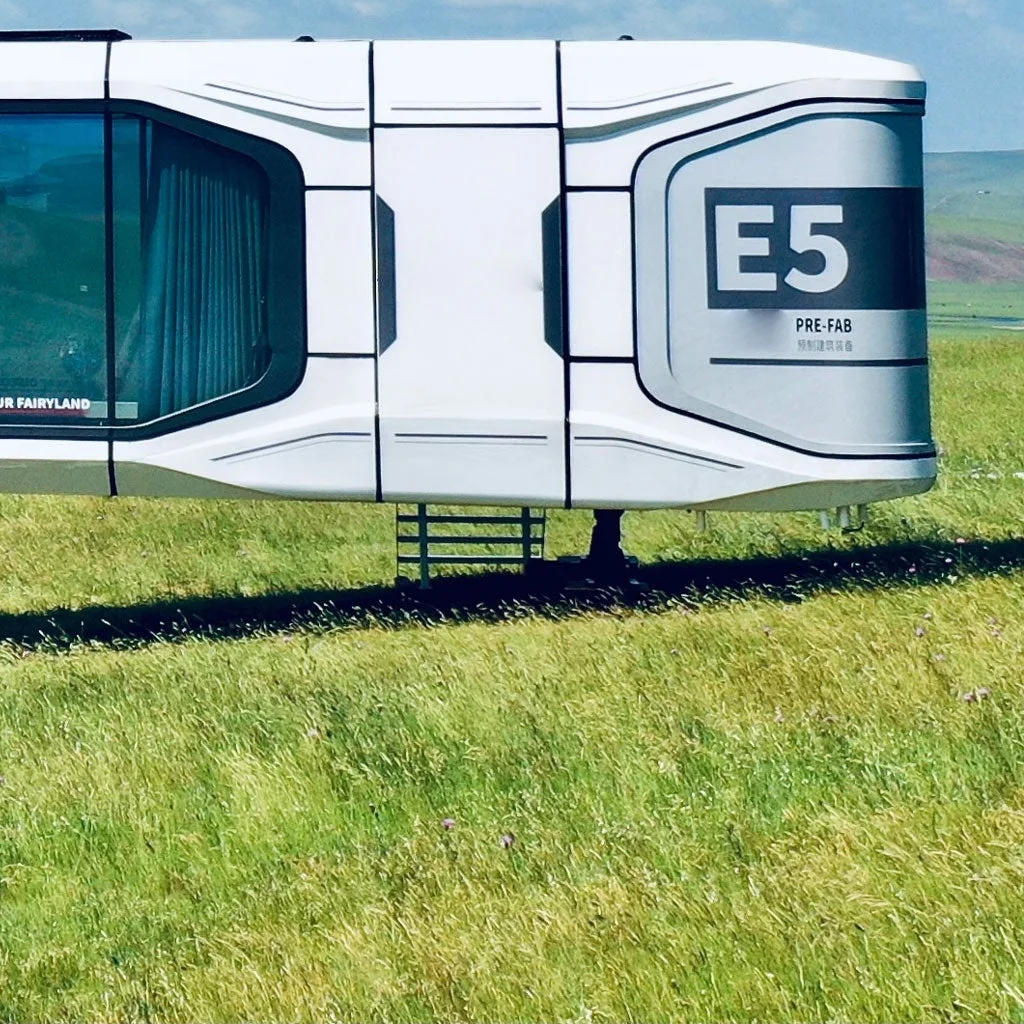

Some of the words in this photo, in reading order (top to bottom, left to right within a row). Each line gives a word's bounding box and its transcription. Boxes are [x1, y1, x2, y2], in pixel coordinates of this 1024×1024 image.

[714, 204, 849, 293] E5
[796, 318, 852, 333] PRE-FAB
[16, 397, 91, 411] FAIRYLAND
